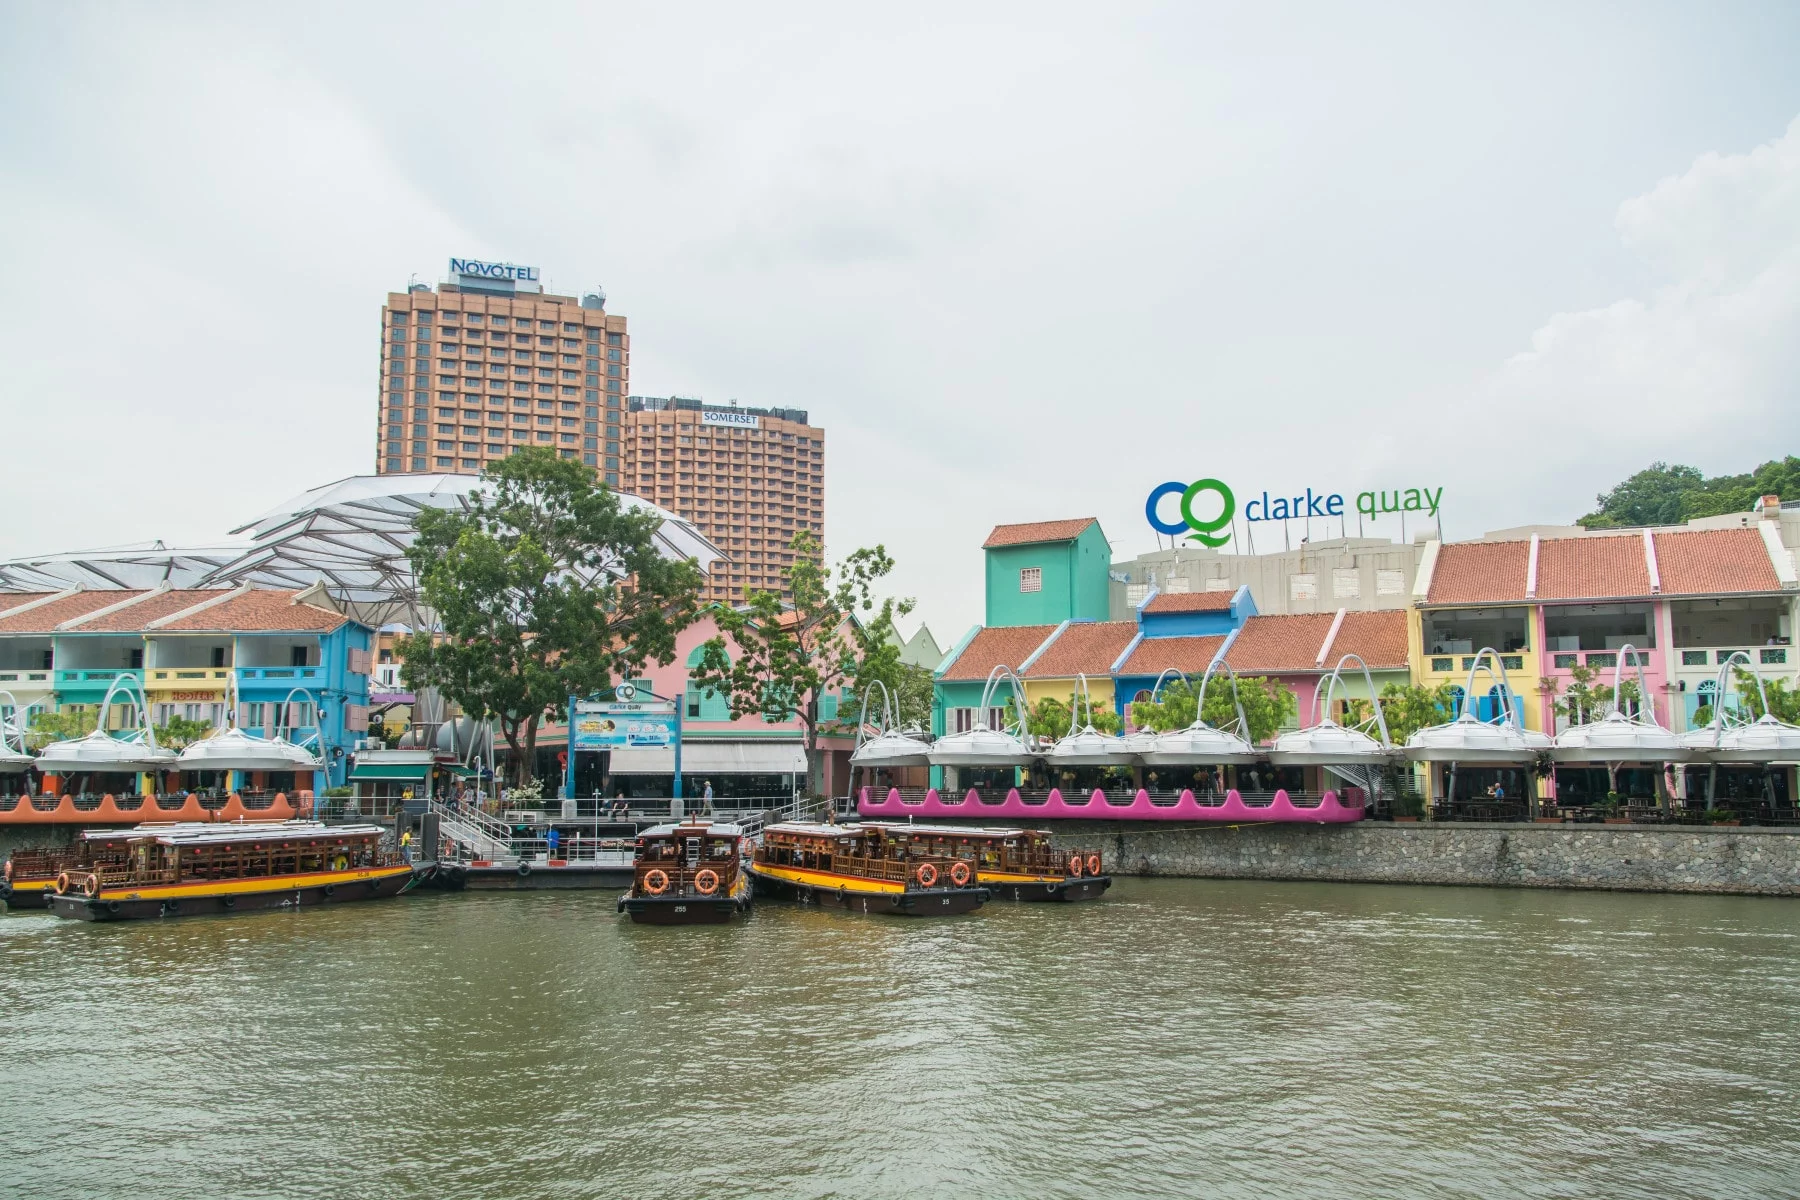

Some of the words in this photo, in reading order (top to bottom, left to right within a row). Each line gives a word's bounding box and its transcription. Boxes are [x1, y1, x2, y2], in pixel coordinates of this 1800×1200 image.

[451, 258, 538, 281] NOVOTEL
[704, 412, 757, 424] SOMERSET
[1245, 487, 1344, 522] clarke
[1356, 487, 1443, 521] quay
[172, 690, 215, 701] HOOTERS
